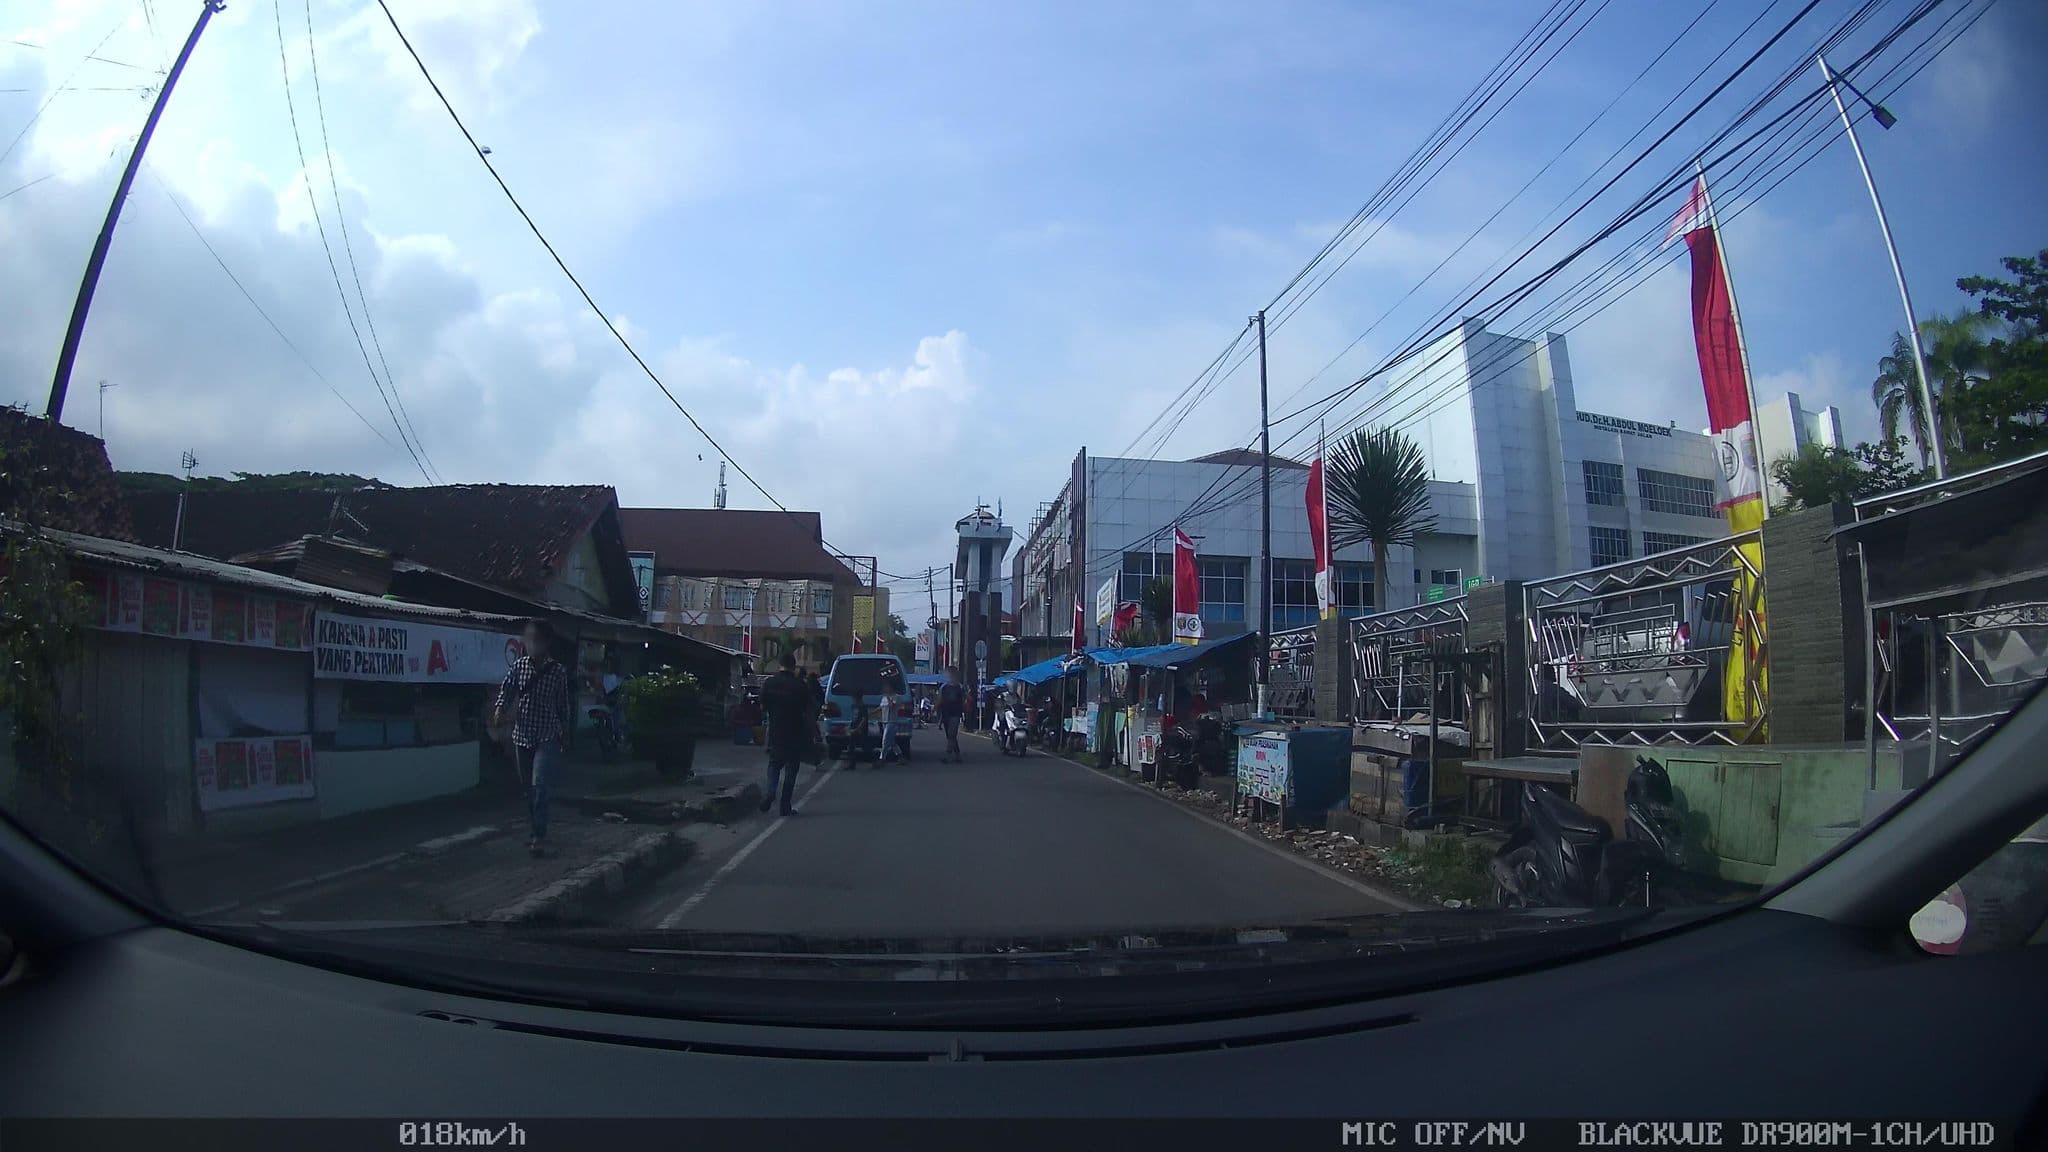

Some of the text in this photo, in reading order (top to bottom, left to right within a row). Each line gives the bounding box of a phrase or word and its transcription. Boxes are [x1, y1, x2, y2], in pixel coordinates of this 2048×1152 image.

[1638, 422, 1672, 437] MOELOEK
[319, 619, 408, 650] KARENA A PASTI
[317, 647, 352, 673] YANG
[354, 650, 405, 676] PERTAMA
